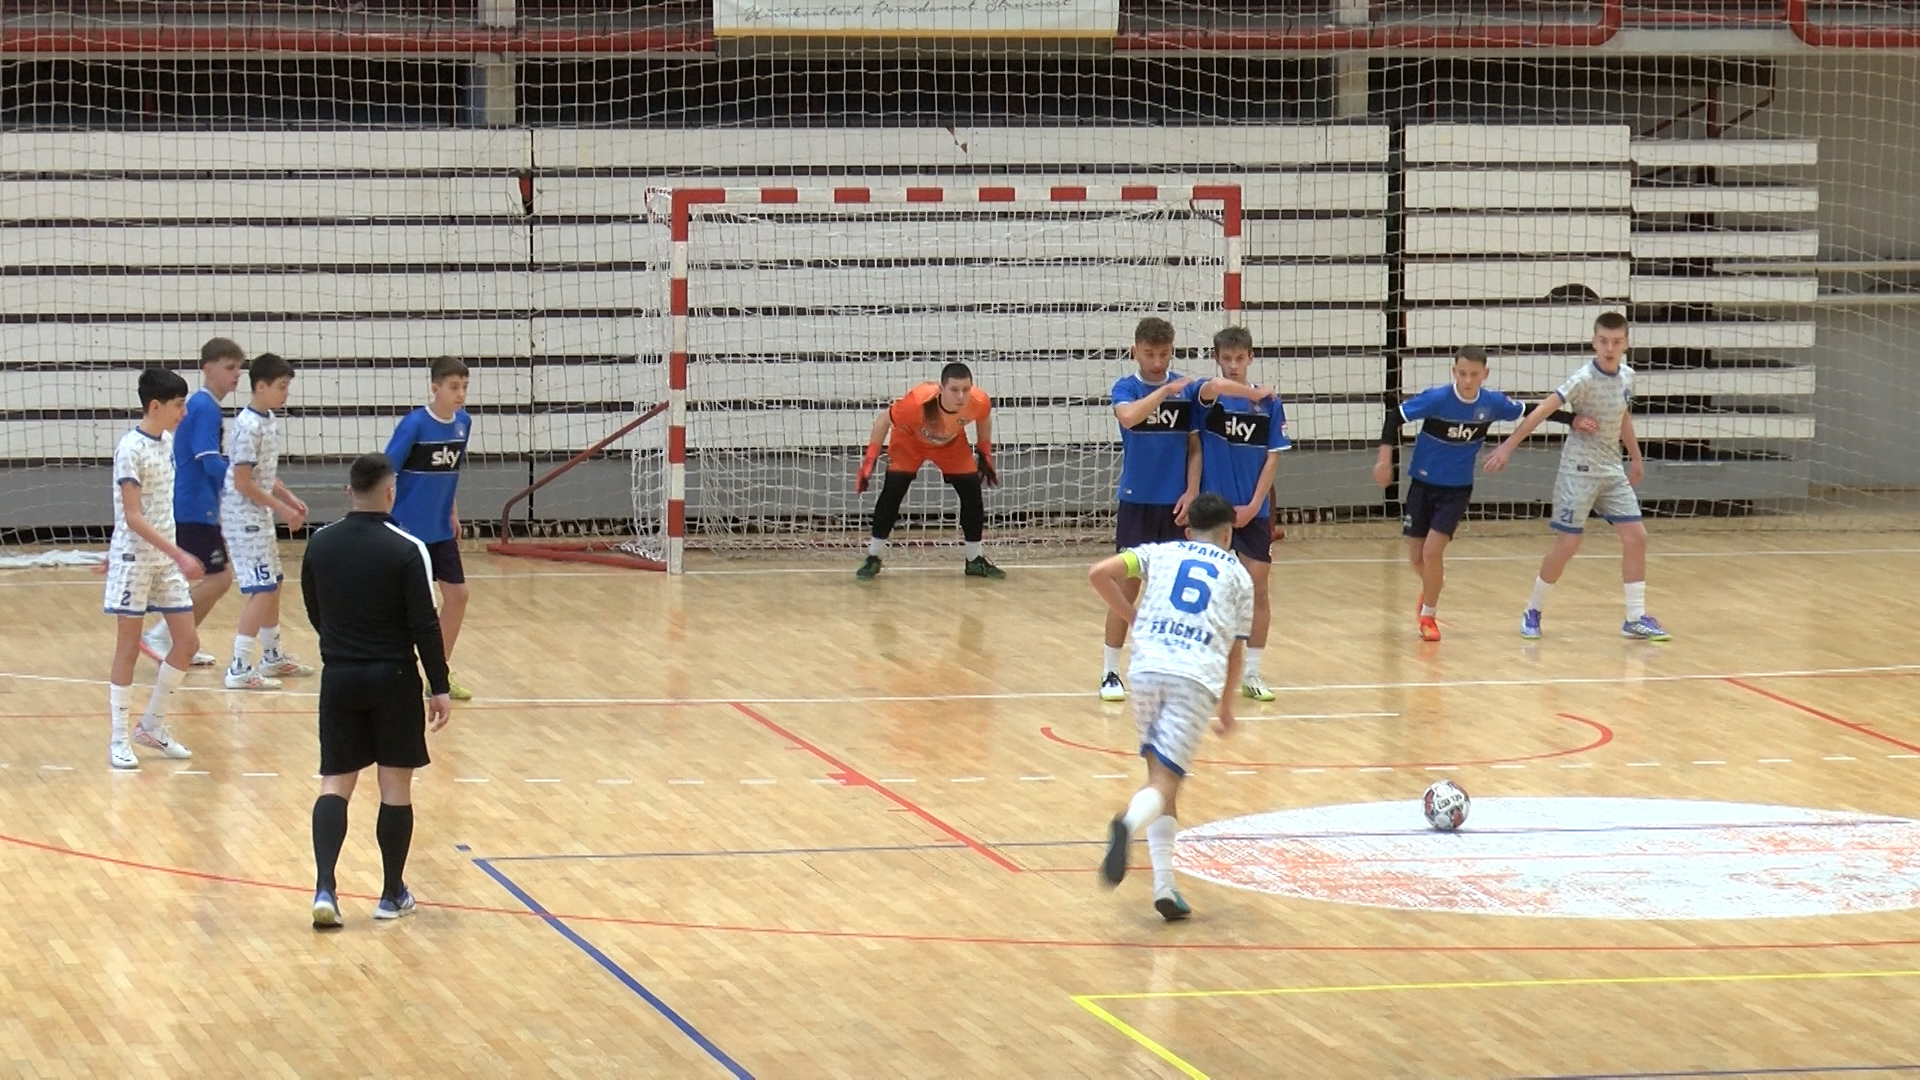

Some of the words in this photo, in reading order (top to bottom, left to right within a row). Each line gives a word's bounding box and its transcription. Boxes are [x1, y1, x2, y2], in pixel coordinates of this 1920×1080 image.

[1146, 405, 1180, 428] sky
[1225, 416, 1256, 442] sky
[1447, 423, 1479, 442] sky
[431, 445, 461, 468] sky
[1560, 507, 1574, 523] 21
[254, 564, 270, 580] 15
[1169, 559, 1220, 614] 6
[121, 590, 131, 606] 2
